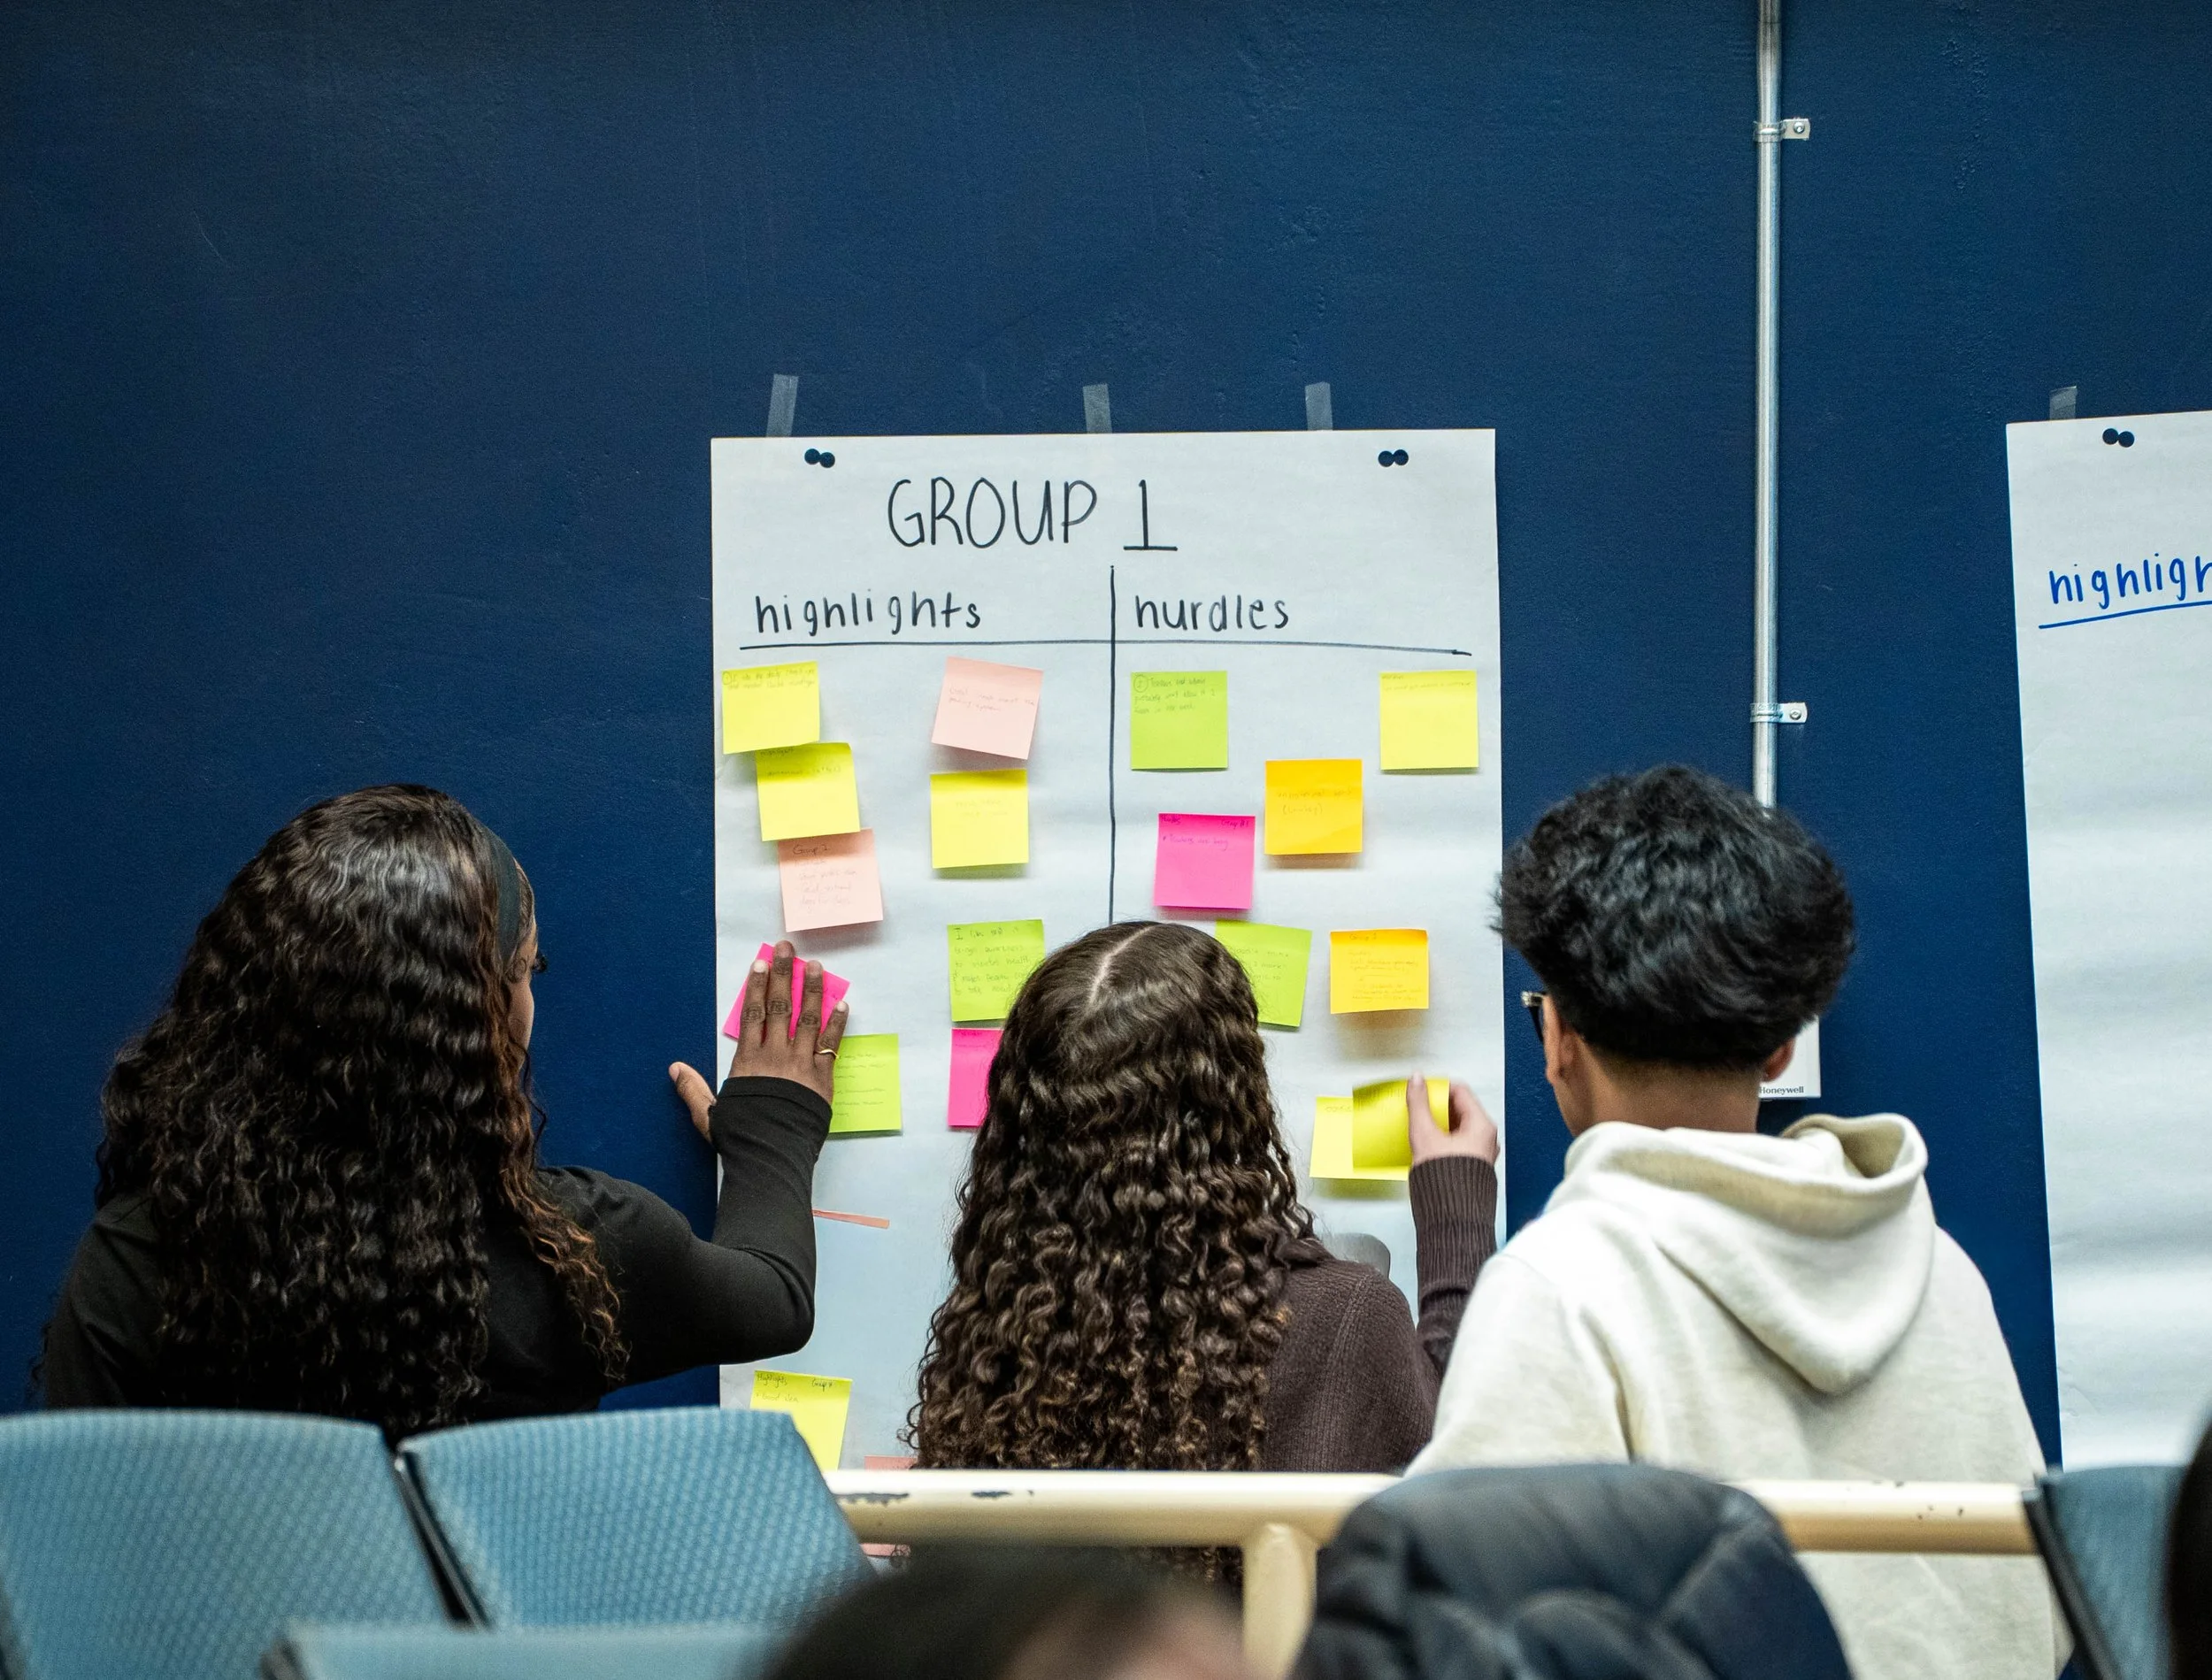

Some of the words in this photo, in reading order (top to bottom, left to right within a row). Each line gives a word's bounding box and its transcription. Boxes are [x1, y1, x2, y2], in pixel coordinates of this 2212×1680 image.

[887, 476, 1097, 548] GROUP
[1123, 479, 1179, 551] 1
[755, 587, 981, 637] highlights
[1134, 594, 1289, 633] hurdles
[1759, 1085, 1804, 1095] Honeywell
